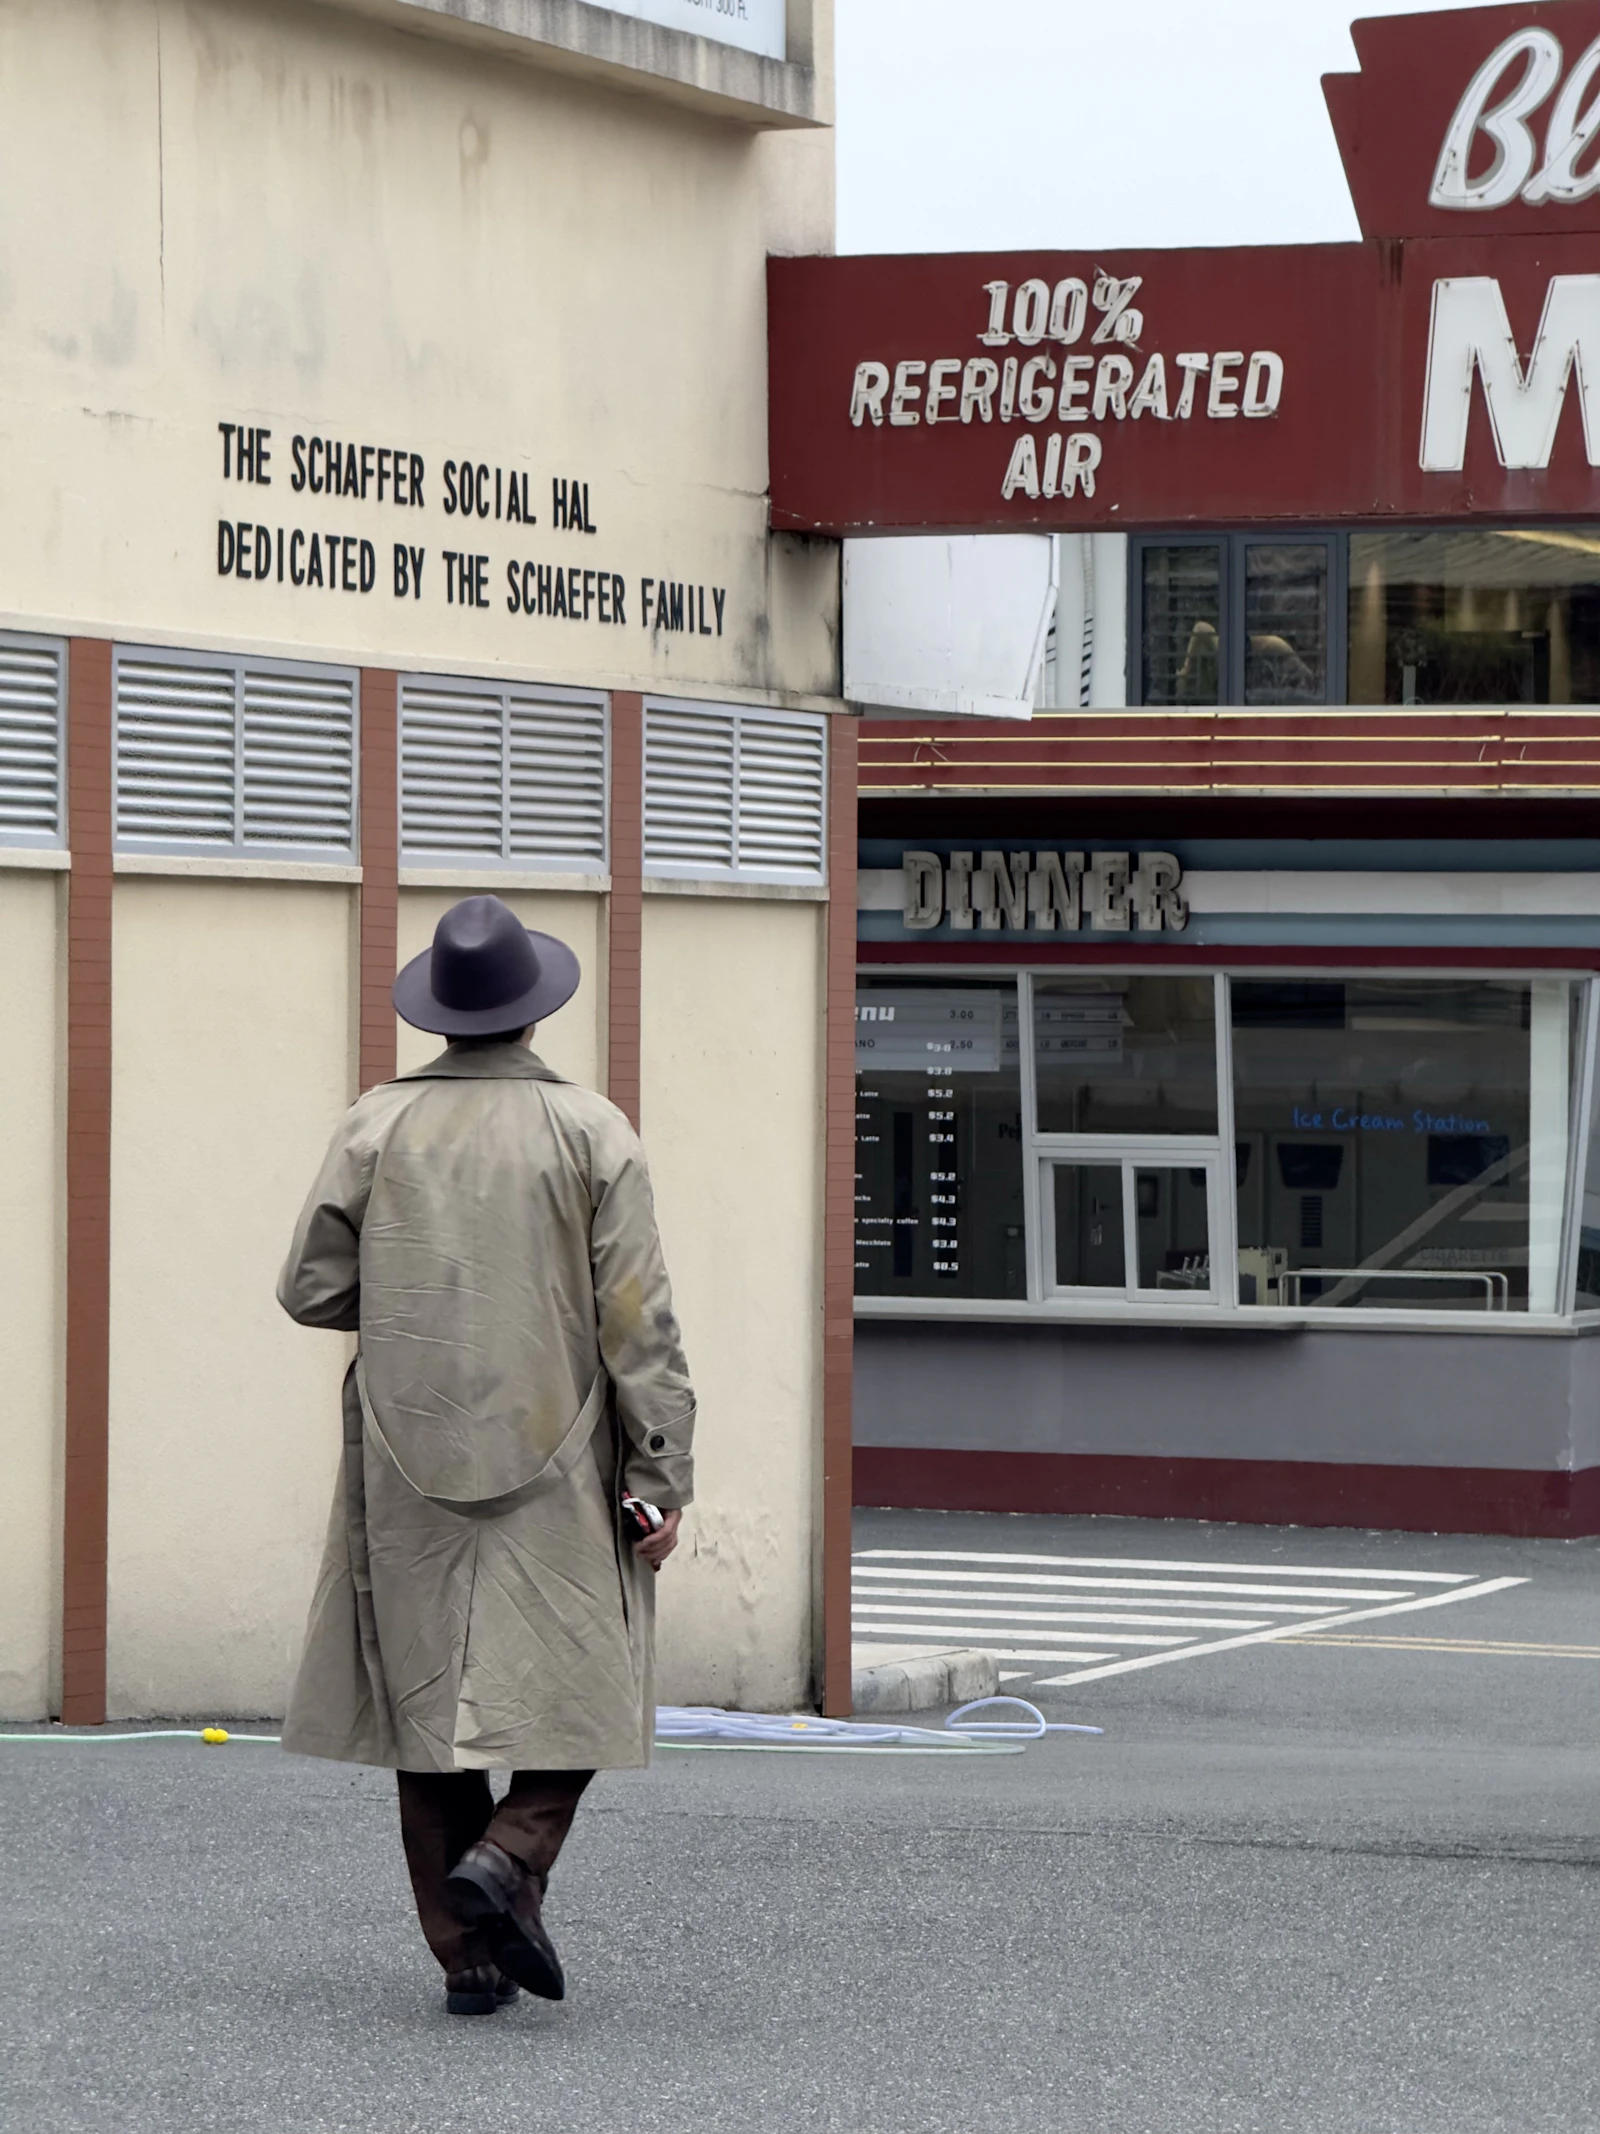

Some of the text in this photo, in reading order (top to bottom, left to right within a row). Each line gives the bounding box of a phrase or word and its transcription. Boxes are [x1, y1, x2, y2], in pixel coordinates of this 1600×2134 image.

[978, 272, 1144, 347] 100%
[1001, 432, 1102, 499] AIR
[218, 422, 597, 534] THE SCHAFFER SOCIAL HAL
[217, 520, 726, 637] DEDICATED BY THE SCHAEFER FAMILY
[902, 849, 1190, 932] DINNER
[950, 1010, 974, 1020] 3.00
[927, 1089, 954, 1098] $5.2
[928, 1111, 954, 1120] $5.2
[1293, 1106, 1491, 1133] Ice Cream Station
[929, 1133, 954, 1142] $3.4
[930, 1172, 956, 1181] $5.2
[931, 1194, 956, 1204] $4.3
[931, 1217, 957, 1226] $4.3
